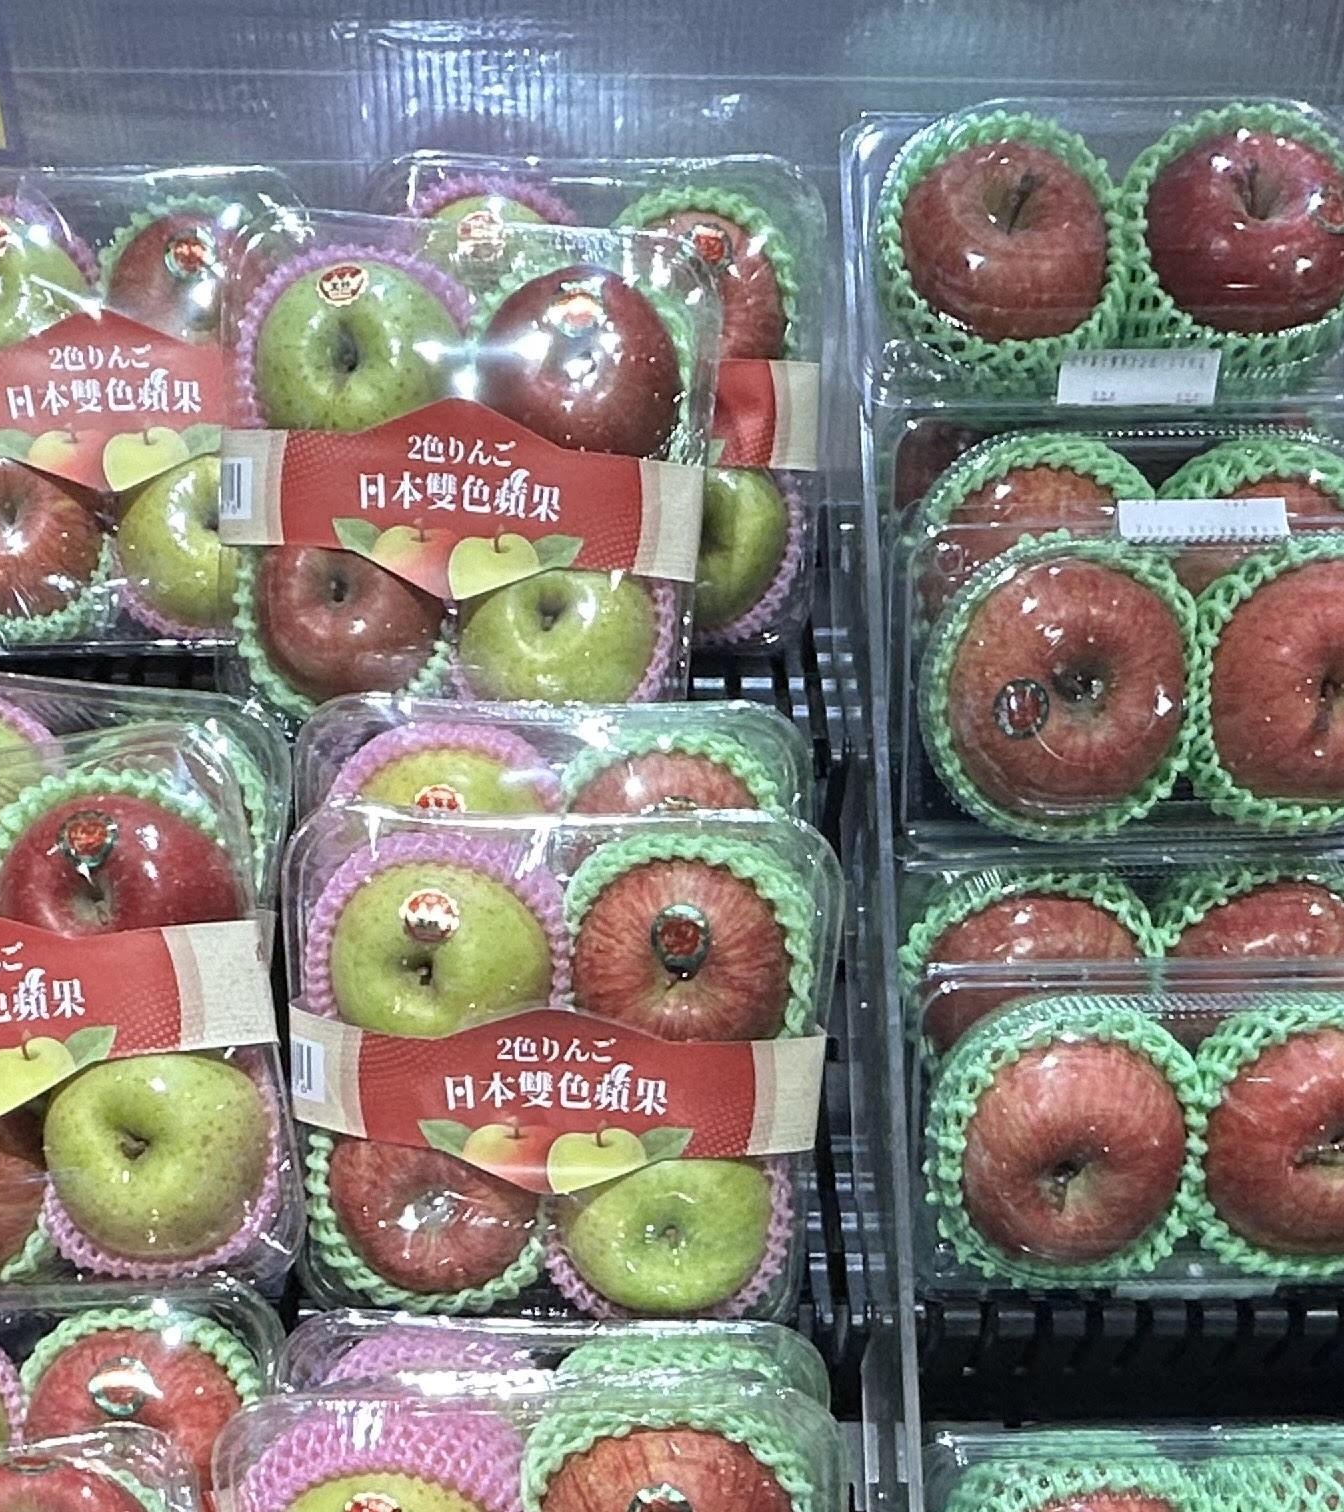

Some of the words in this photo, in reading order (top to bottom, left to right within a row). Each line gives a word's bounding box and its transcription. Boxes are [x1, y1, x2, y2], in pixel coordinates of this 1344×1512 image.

[48, 344, 152, 371] 2色りんご
[7, 369, 202, 419] 日本雙色蘋果
[408, 433, 516, 465] 2色りんご
[359, 468, 561, 522] 日本雙色蘋果
[497, 1036, 616, 1063] 2色りんご
[444, 1063, 668, 1116] 日本雙色蘋果
